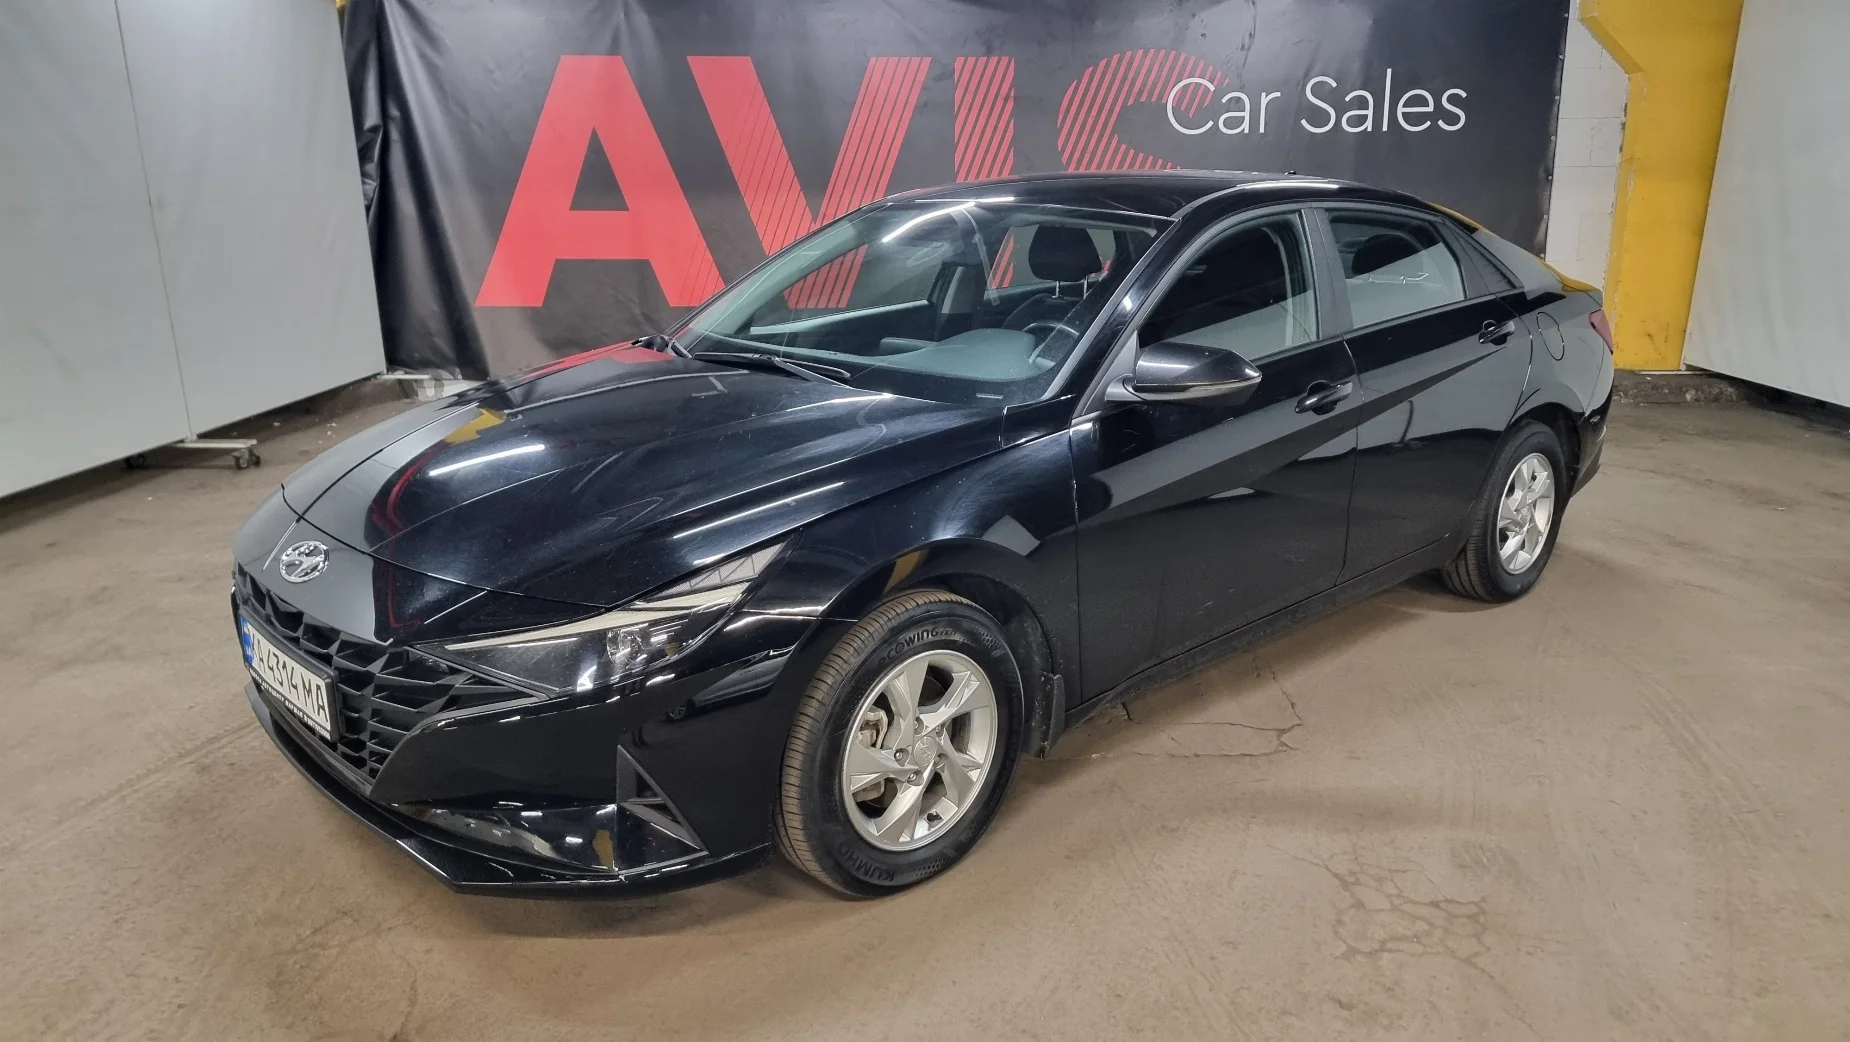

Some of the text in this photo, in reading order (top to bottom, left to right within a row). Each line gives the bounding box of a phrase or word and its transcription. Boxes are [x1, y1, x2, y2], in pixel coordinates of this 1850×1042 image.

[1166, 68, 1468, 135] Car Sales
[267, 648, 300, 701] 4314
[301, 672, 329, 723] MA
